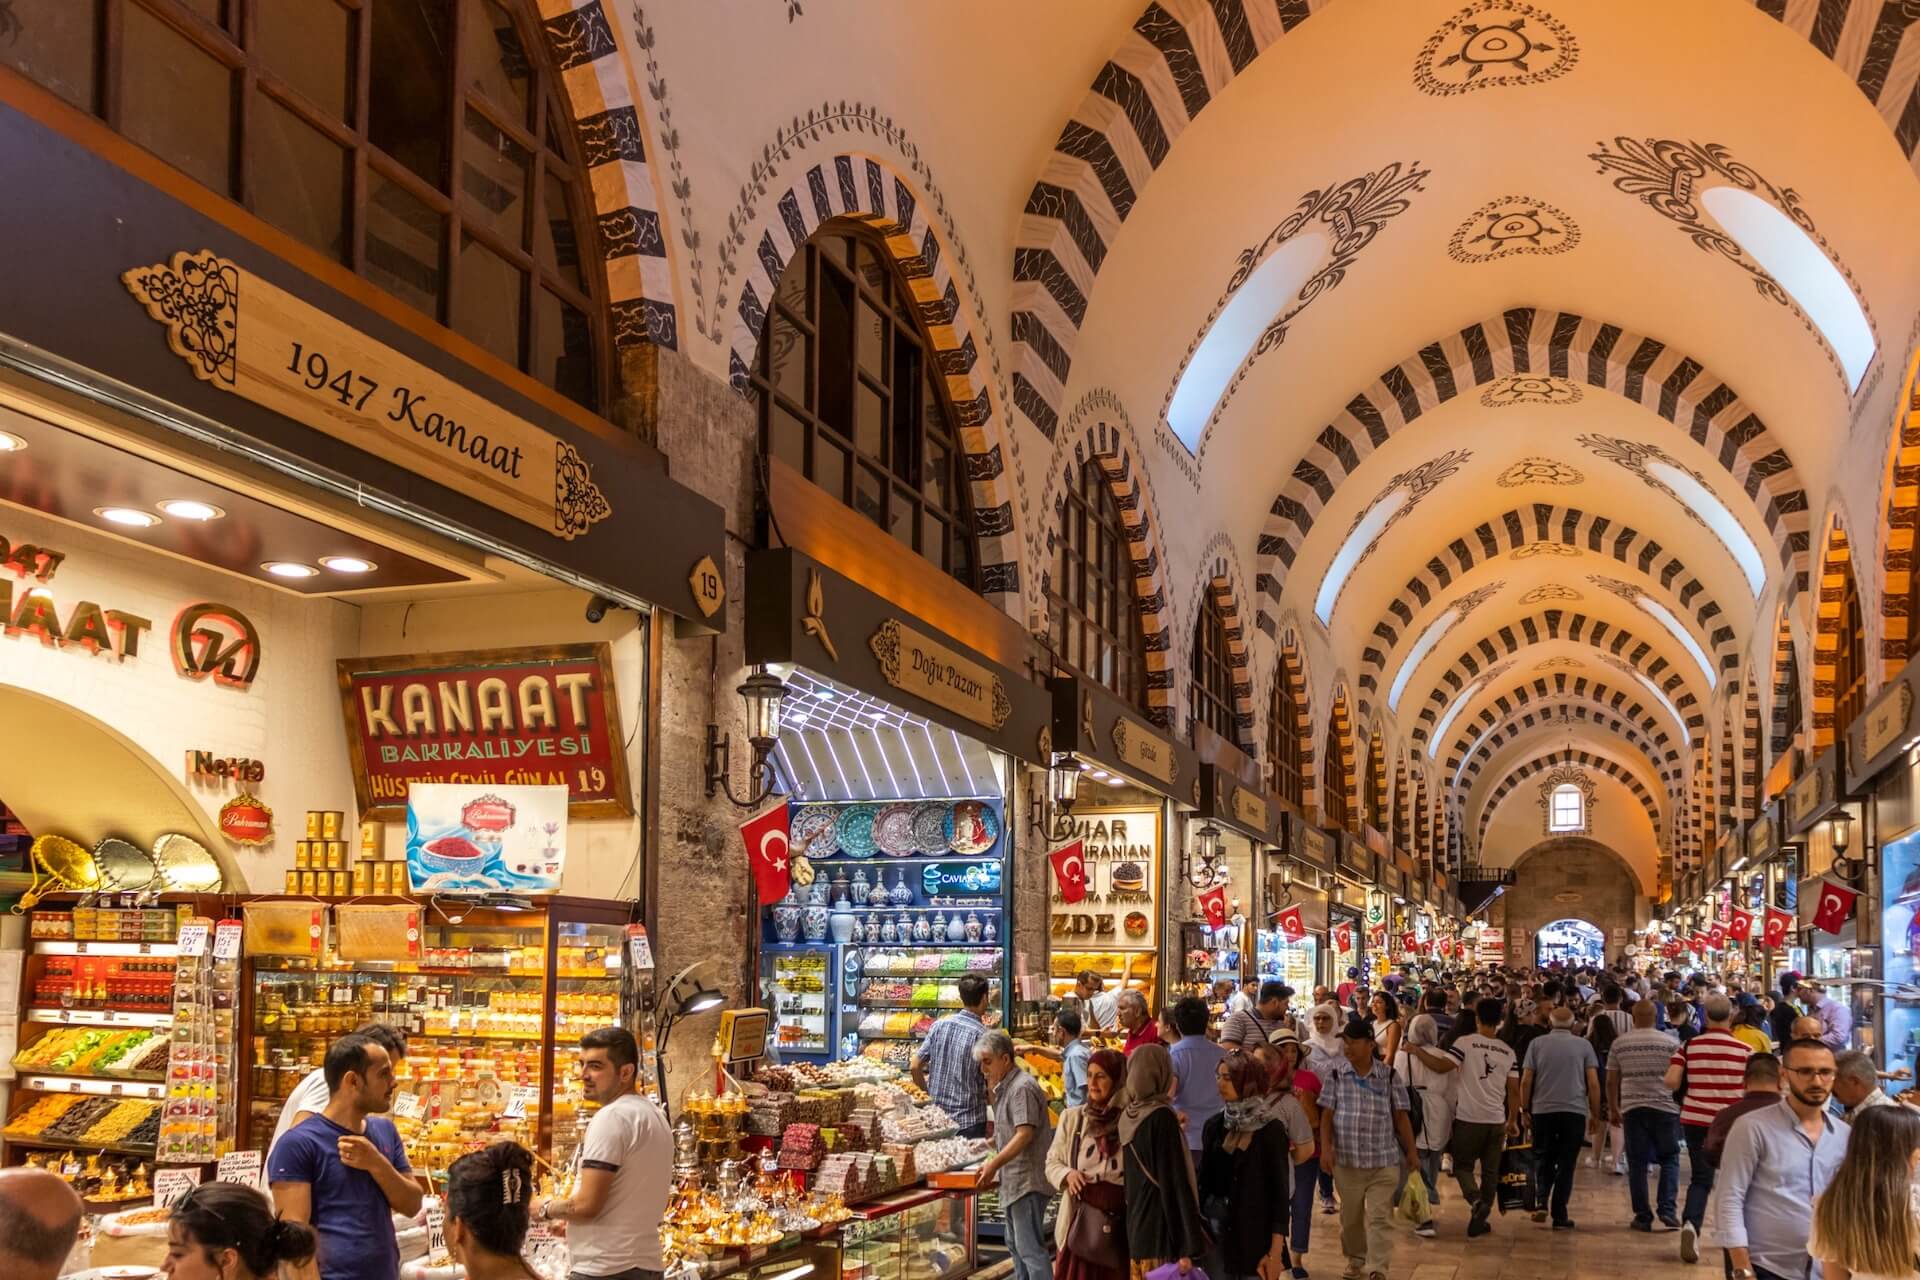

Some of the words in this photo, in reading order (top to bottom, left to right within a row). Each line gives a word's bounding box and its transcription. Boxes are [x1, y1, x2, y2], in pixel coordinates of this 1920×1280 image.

[286, 342, 379, 413] 1947
[387, 386, 524, 480] Kanaat
[700, 569, 718, 601] 19
[911, 648, 944, 687] Doğu
[946, 665, 984, 703] Pazarı
[361, 671, 593, 737] KANAAT
[380, 734, 592, 764] BAKKALİYESİ
[578, 767, 607, 793] 19
[1083, 844, 1151, 858] IRANIAN
[941, 873, 975, 885] CAVIAR
